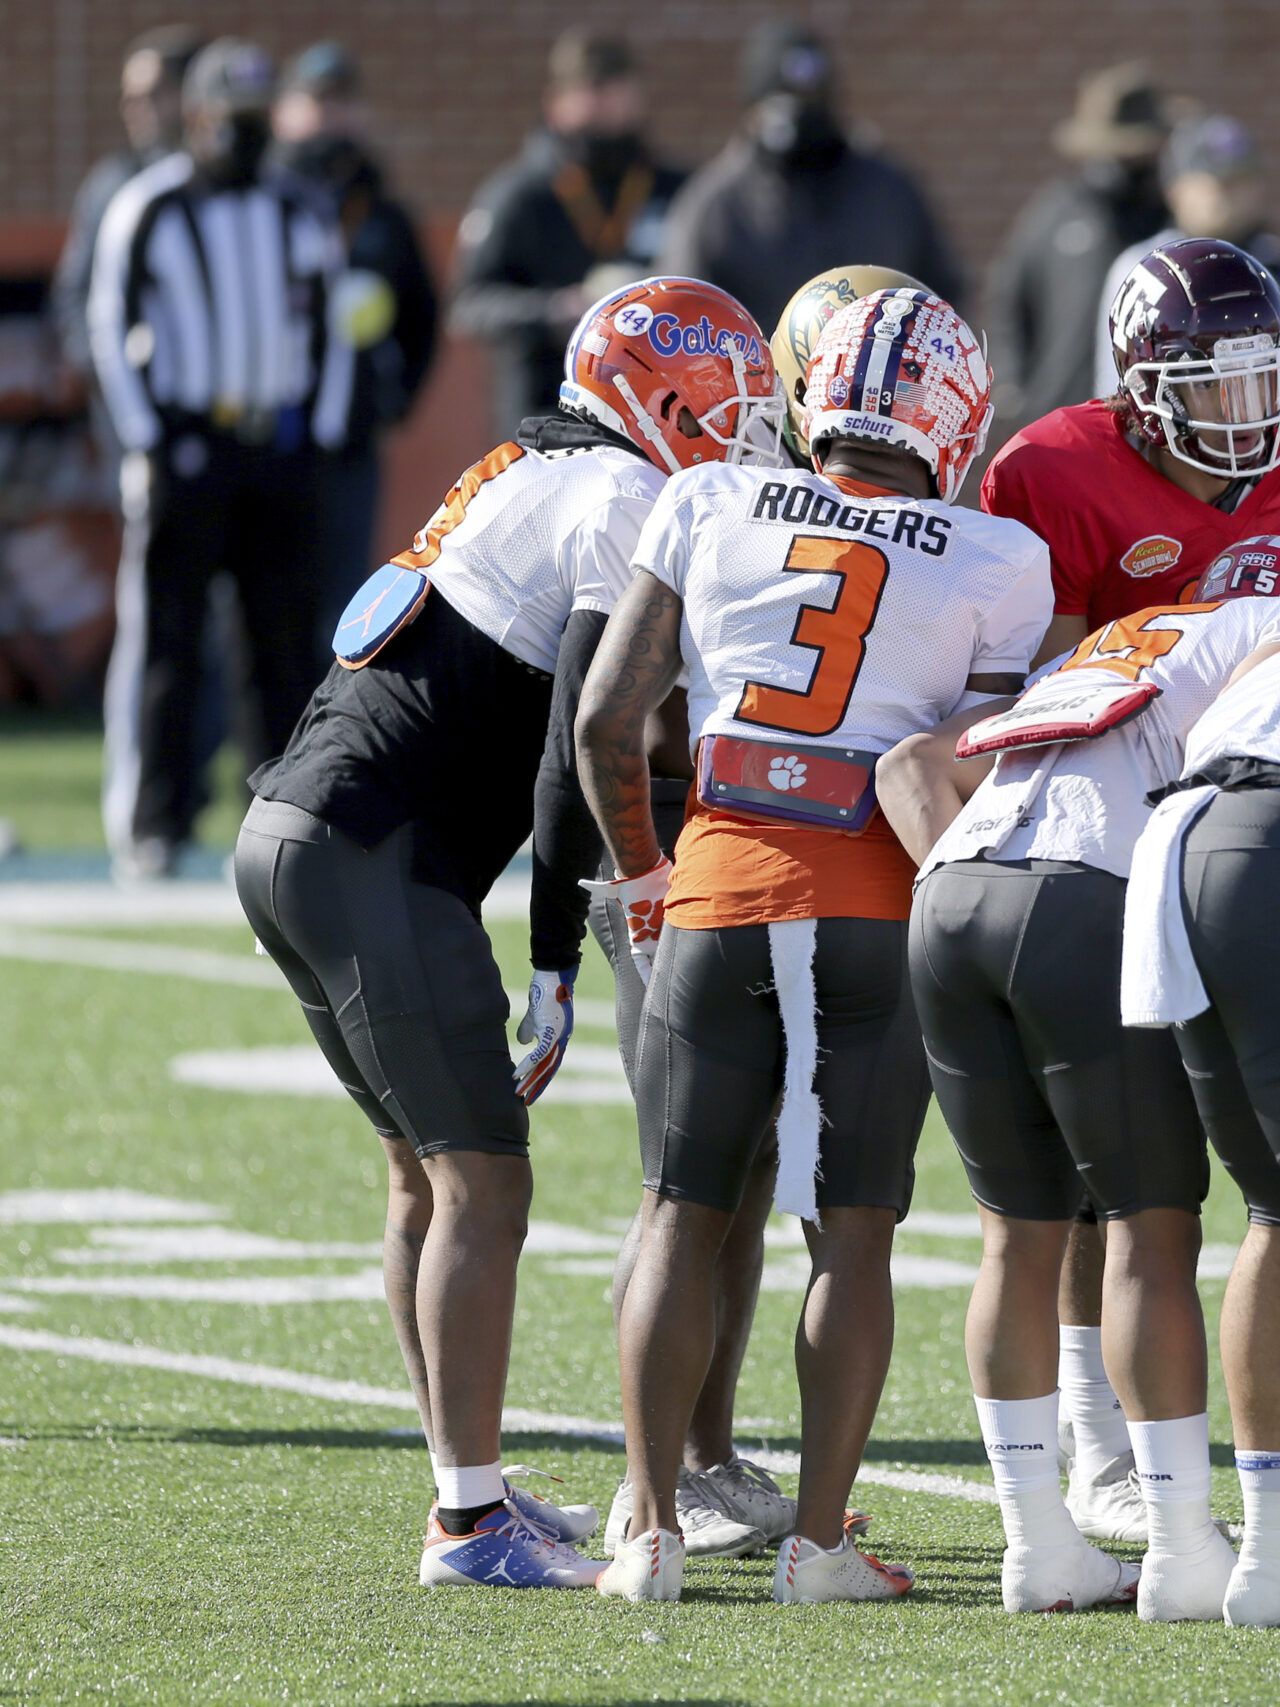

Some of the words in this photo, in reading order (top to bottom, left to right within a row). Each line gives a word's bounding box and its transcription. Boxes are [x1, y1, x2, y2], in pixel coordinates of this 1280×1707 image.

[622, 309, 648, 331] 44
[931, 338, 956, 362] 44
[881, 391, 891, 405] 3
[844, 416, 894, 436] schutt
[753, 482, 952, 557] RODGERS
[1238, 552, 1276, 568] SBC
[733, 534, 890, 737] 3
[529, 1025, 555, 1065] GATORS
[986, 1443, 1044, 1451] VAPOR
